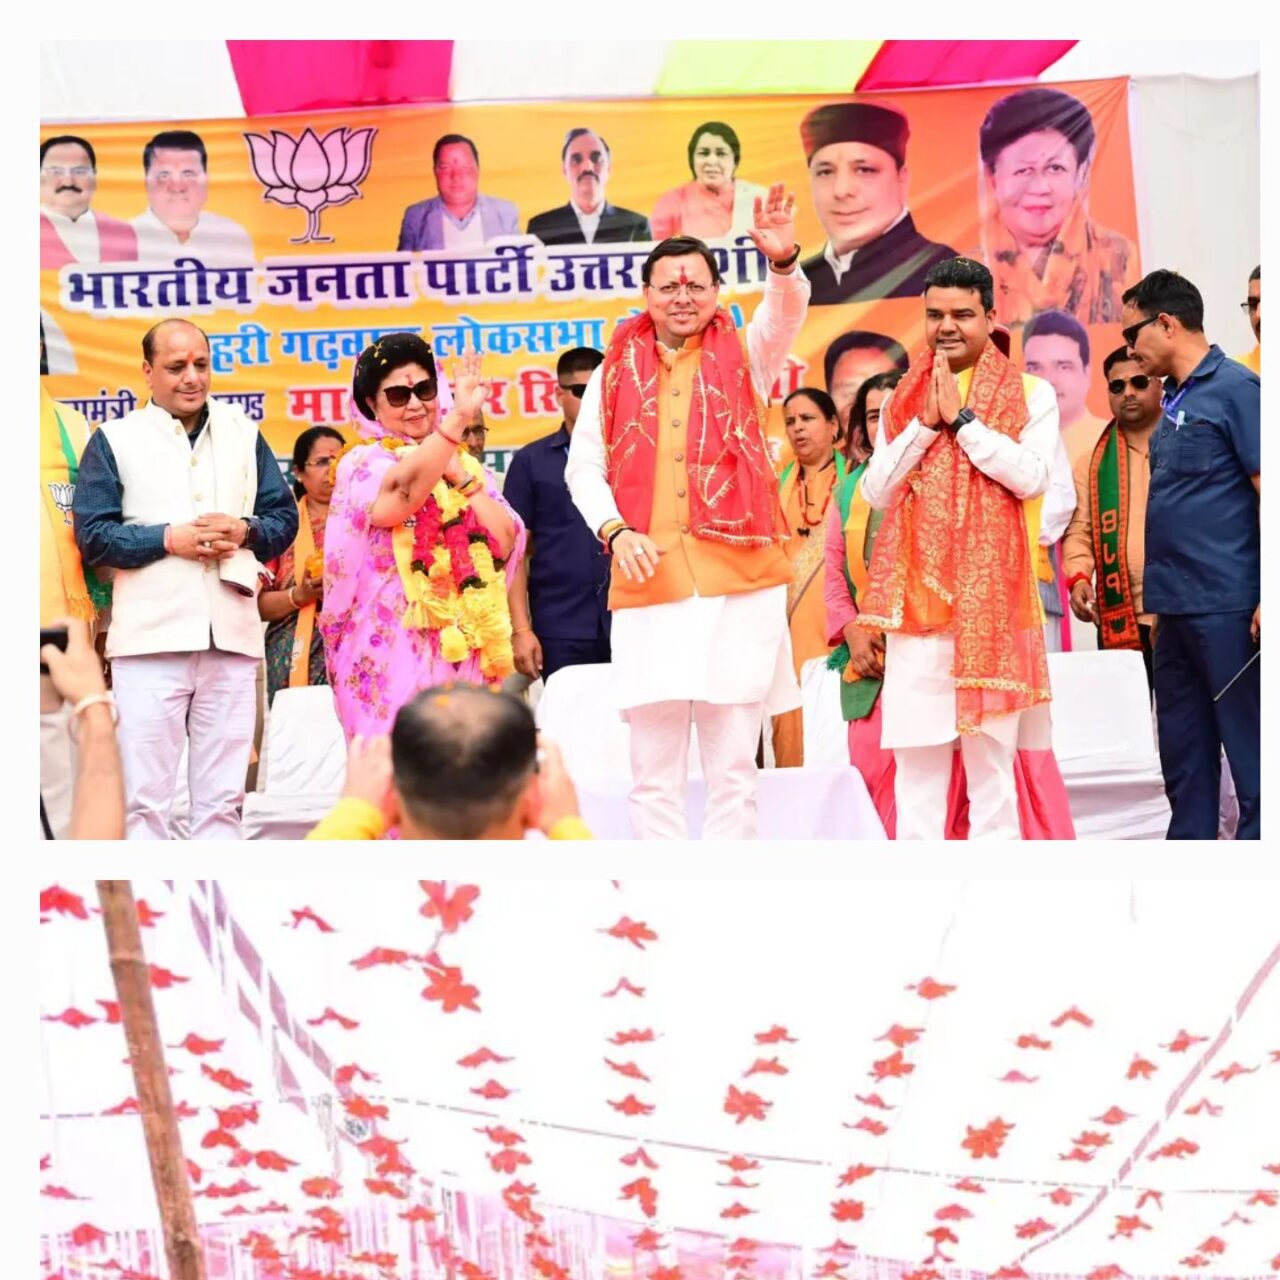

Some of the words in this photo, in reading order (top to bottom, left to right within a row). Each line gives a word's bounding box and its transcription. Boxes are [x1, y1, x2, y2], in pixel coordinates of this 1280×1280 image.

[68, 257, 254, 309] भारतीय
[266, 261, 411, 302] जनता
[423, 244, 536, 297] पार्टी
[433, 314, 606, 358] लोकसभा
